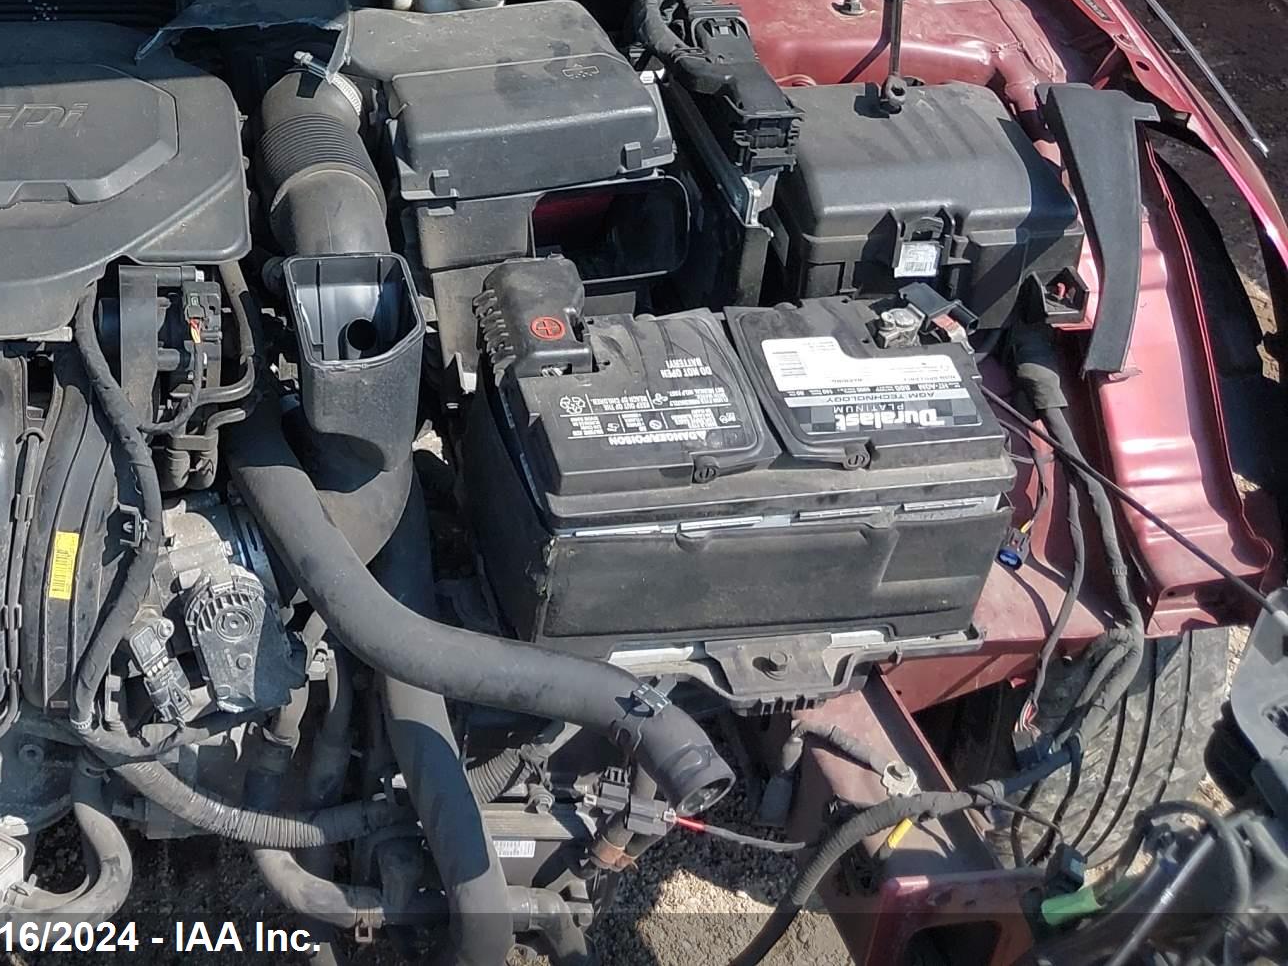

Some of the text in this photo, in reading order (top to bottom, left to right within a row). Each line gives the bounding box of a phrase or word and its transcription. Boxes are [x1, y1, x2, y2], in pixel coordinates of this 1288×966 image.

[665, 357, 703, 369] BATTERY!
[660, 365, 713, 379] DO NOT OPEN
[826, 394, 905, 403] TECHNOLOGY
[908, 391, 935, 399] AGM
[833, 403, 905, 414] PLATINUM
[835, 409, 945, 431] Duralast
